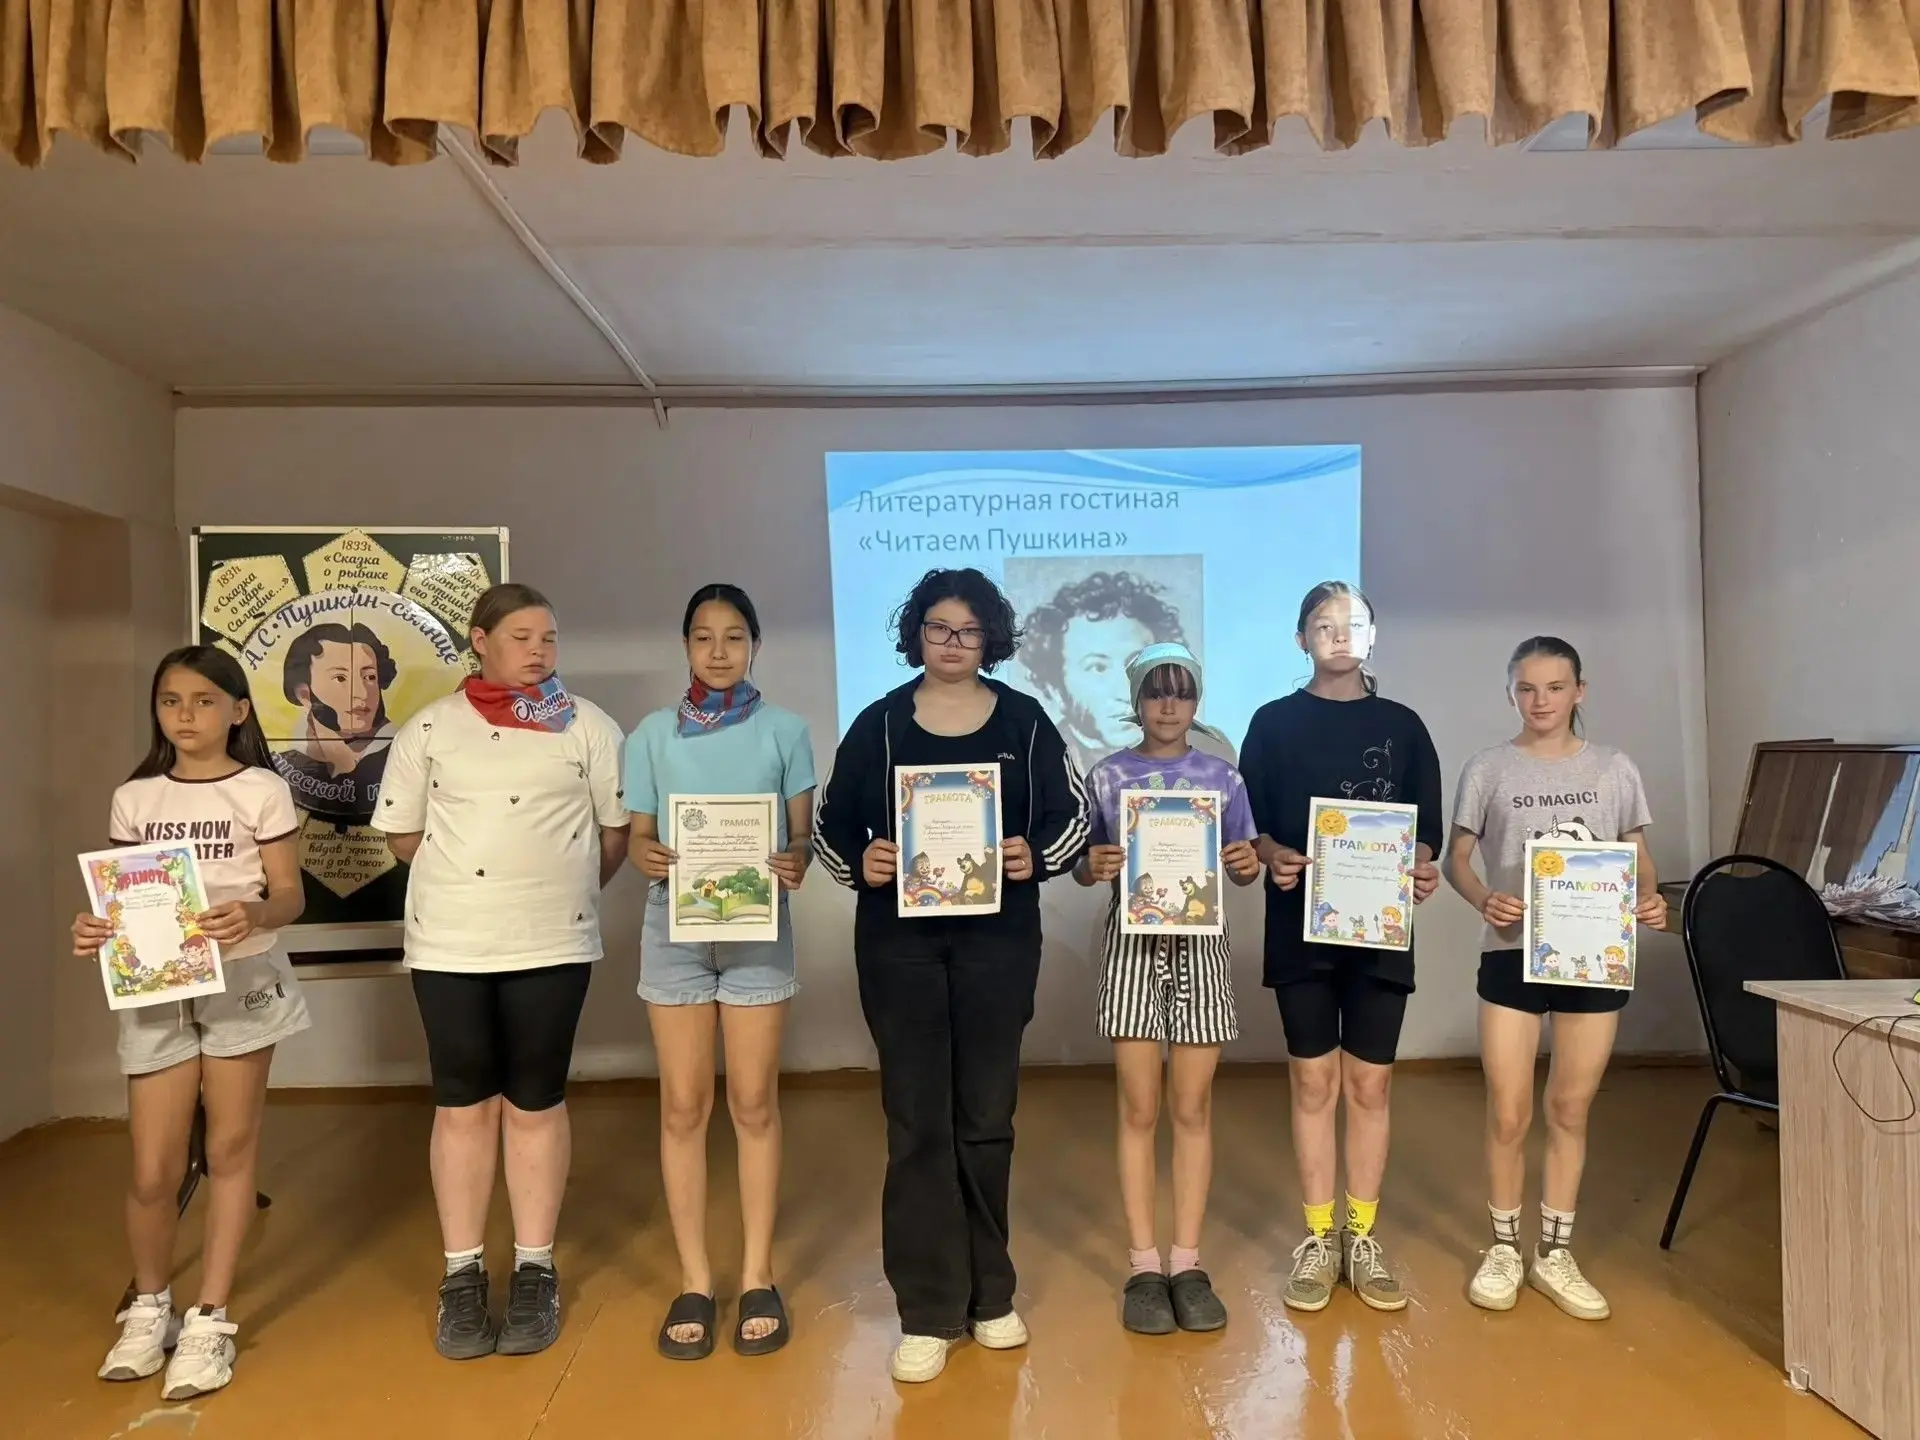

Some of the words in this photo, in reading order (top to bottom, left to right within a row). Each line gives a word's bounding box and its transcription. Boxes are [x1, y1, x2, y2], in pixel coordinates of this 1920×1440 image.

[855, 489, 1052, 517] Литературная
[1060, 490, 1180, 511] гостиная
[859, 528, 981, 552] «Читаем
[987, 527, 1128, 555] Пушкина»
[323, 551, 380, 569] «Сказка
[338, 566, 389, 581] рыбаке
[213, 572, 258, 613] «Сказка
[238, 582, 265, 607] царе
[924, 791, 973, 804] ГРАМОТА
[1512, 795, 1534, 809] SO
[1539, 791, 1599, 807] MAGIC!
[145, 822, 186, 841] KISS
[189, 820, 231, 840] NOW
[719, 818, 761, 827] ГРАМОТА
[1332, 838, 1398, 854] ГРАМОТА
[116, 868, 172, 890] ГРАМОТА
[1549, 879, 1619, 893] ГРАМОТА
